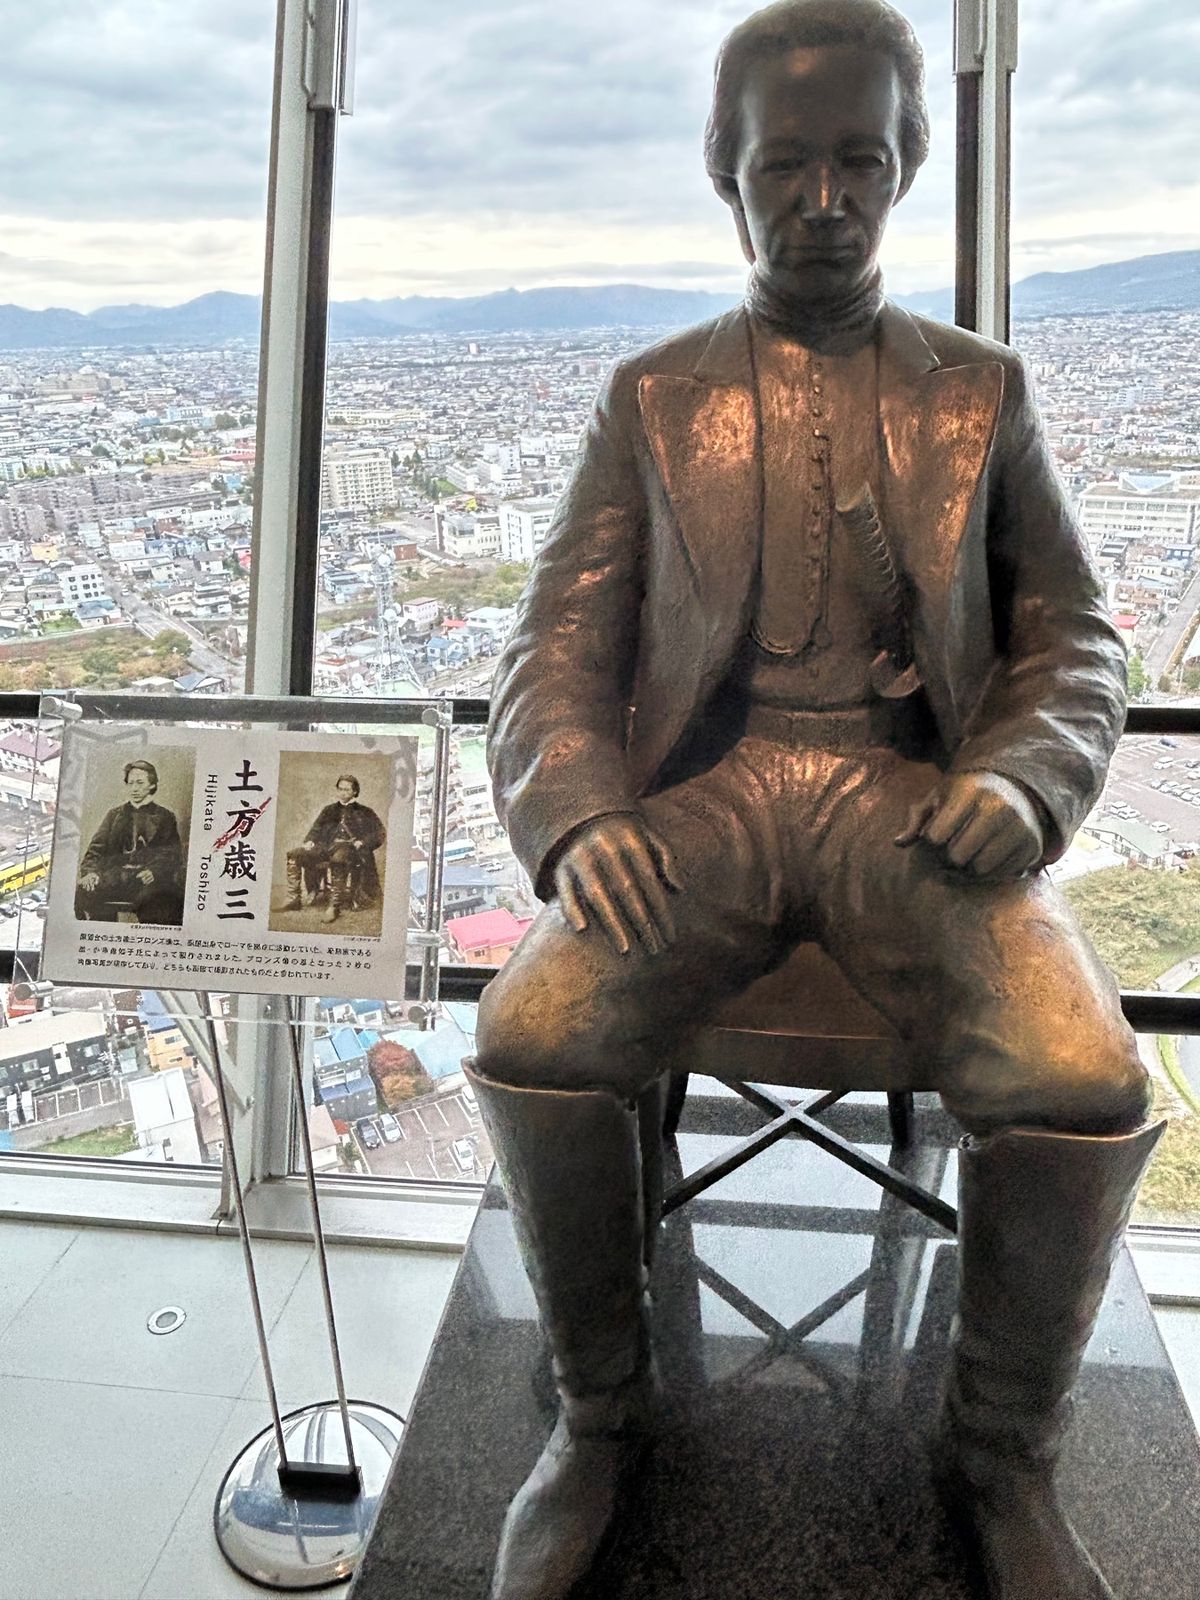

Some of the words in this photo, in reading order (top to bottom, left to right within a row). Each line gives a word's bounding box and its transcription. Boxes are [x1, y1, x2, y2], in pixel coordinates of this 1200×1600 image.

[204, 774, 218, 831] Hijikata
[217, 759, 263, 920] 土方歳三
[197, 854, 212, 911] Toshizo
